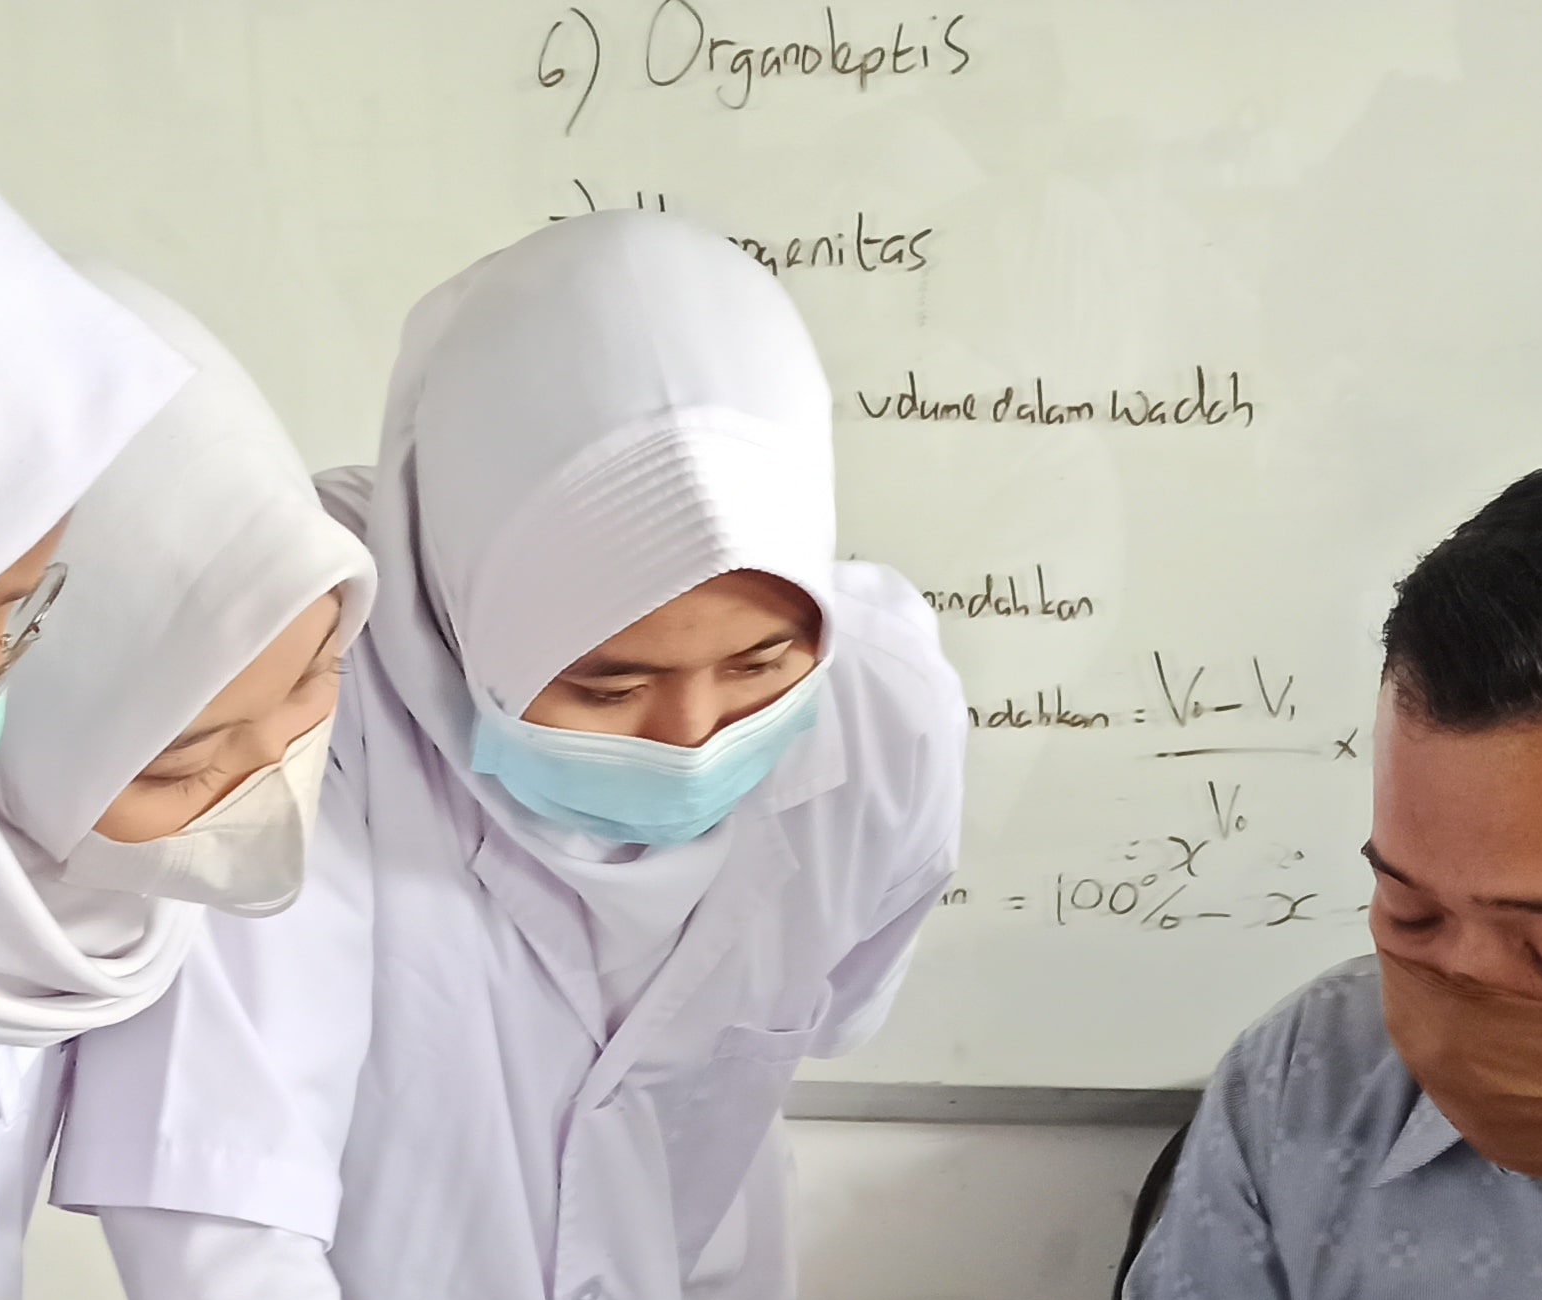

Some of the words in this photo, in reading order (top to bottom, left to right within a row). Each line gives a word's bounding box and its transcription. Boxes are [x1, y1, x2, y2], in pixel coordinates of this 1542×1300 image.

[537, 6, 602, 137] 6)
[645, 0, 972, 110] Organoleptis
[992, 376, 1095, 425] dalam
[966, 684, 1111, 730] ndahkan
